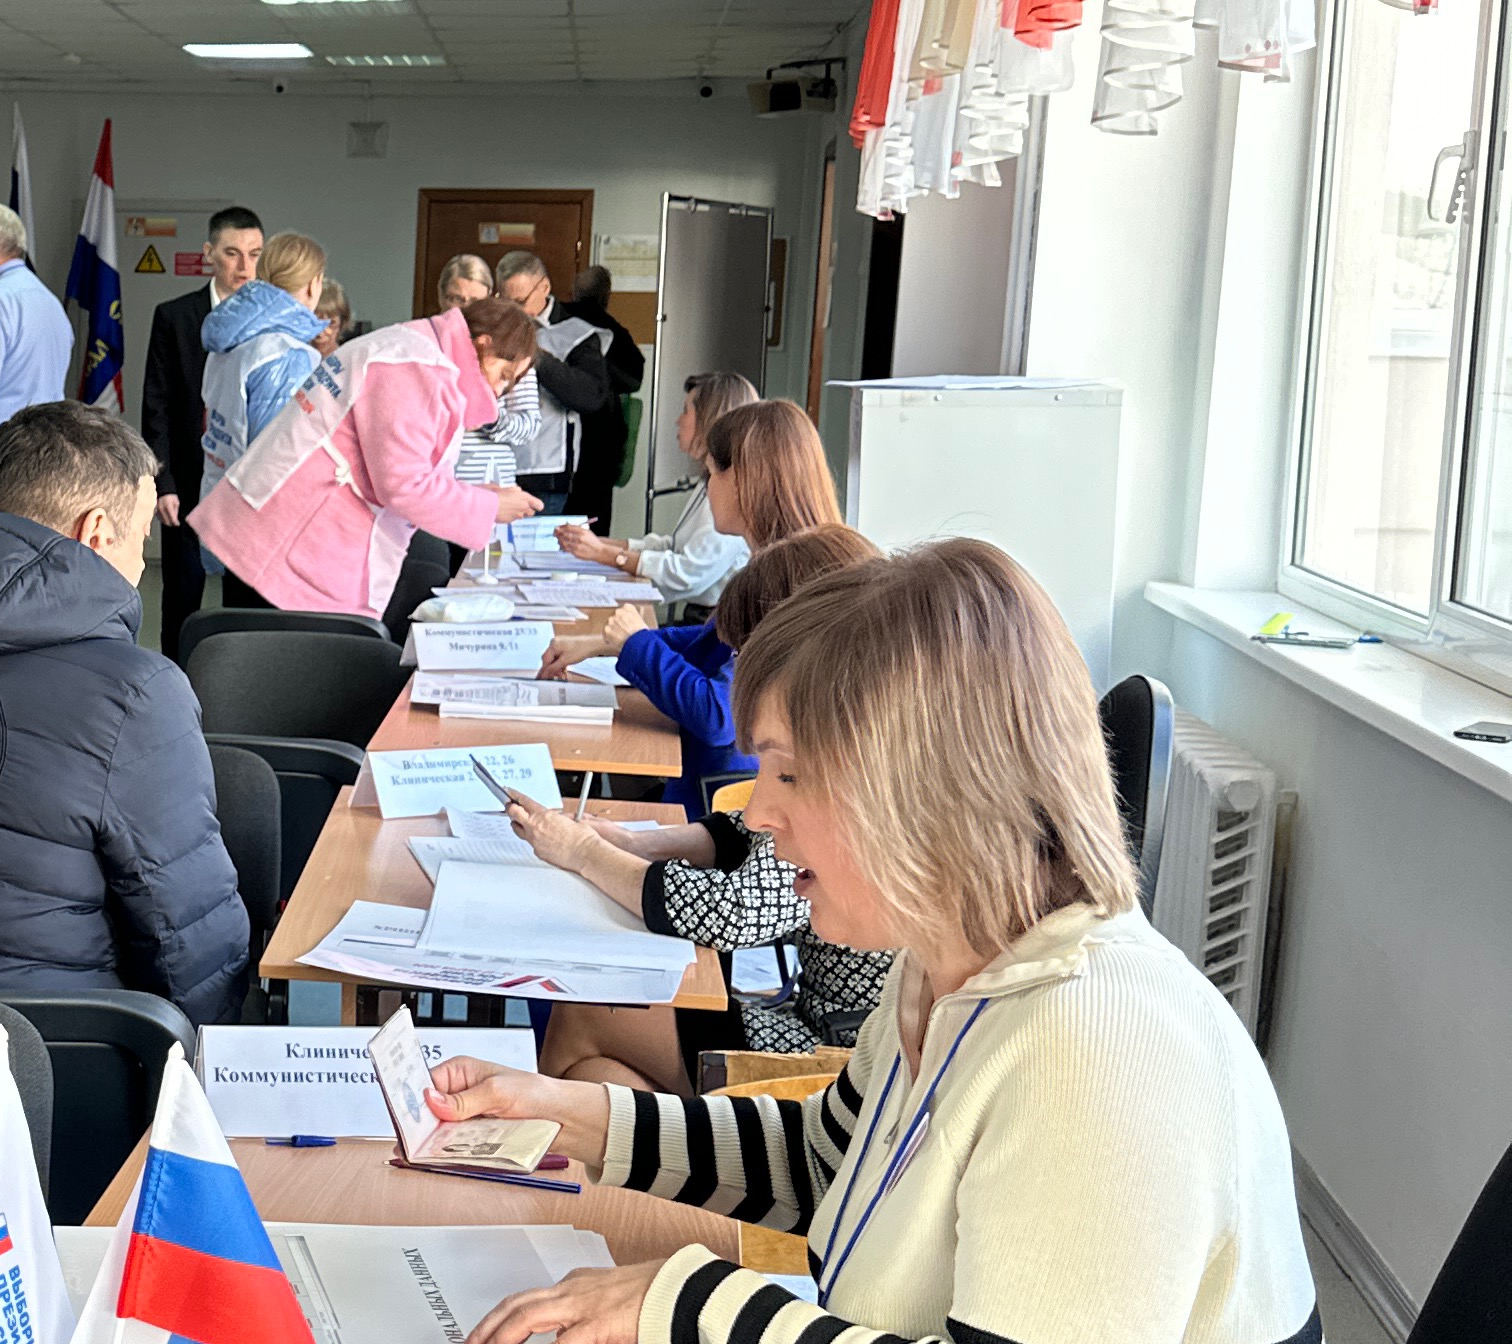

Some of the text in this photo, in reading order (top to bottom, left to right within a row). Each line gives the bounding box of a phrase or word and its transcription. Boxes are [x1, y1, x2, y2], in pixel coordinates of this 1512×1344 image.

[401, 759, 472, 771] Владимирск
[391, 774, 465, 786] Клиническая
[285, 1042, 372, 1060] Клиниче
[213, 1066, 378, 1087] Коммунистическ
[401, 1247, 441, 1289] ДАННЫХ
